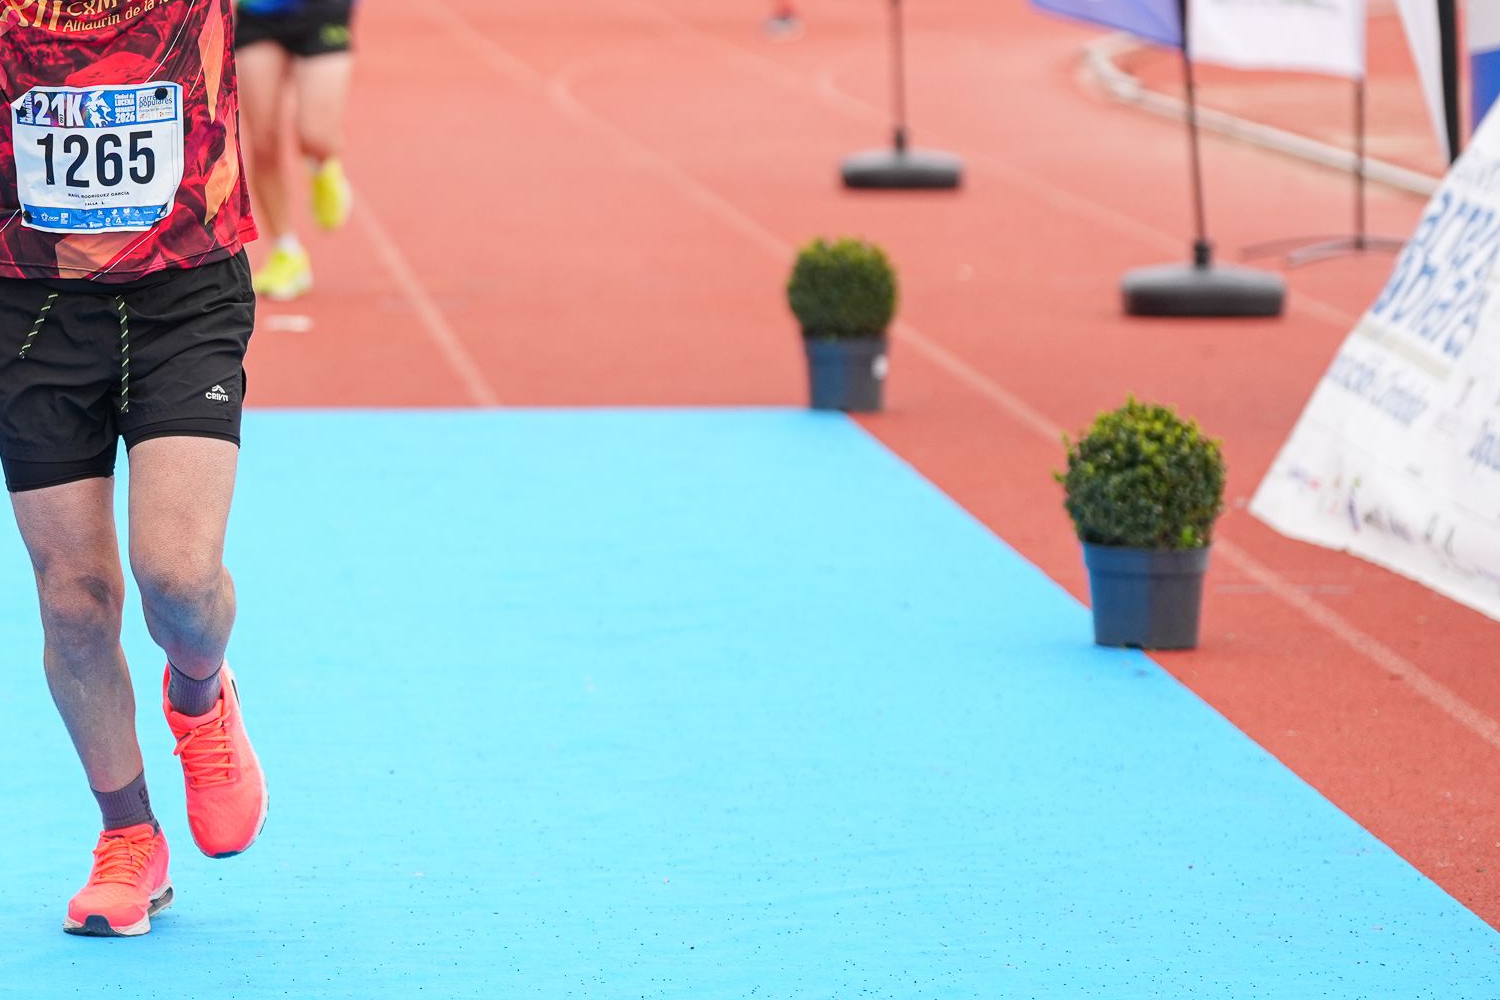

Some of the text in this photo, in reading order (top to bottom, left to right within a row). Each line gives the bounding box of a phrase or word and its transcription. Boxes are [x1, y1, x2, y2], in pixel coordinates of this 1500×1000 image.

[126, 6, 141, 20] de
[34, 93, 84, 127] 21K
[115, 112, 135, 124] 2026
[36, 131, 155, 188] 1265
